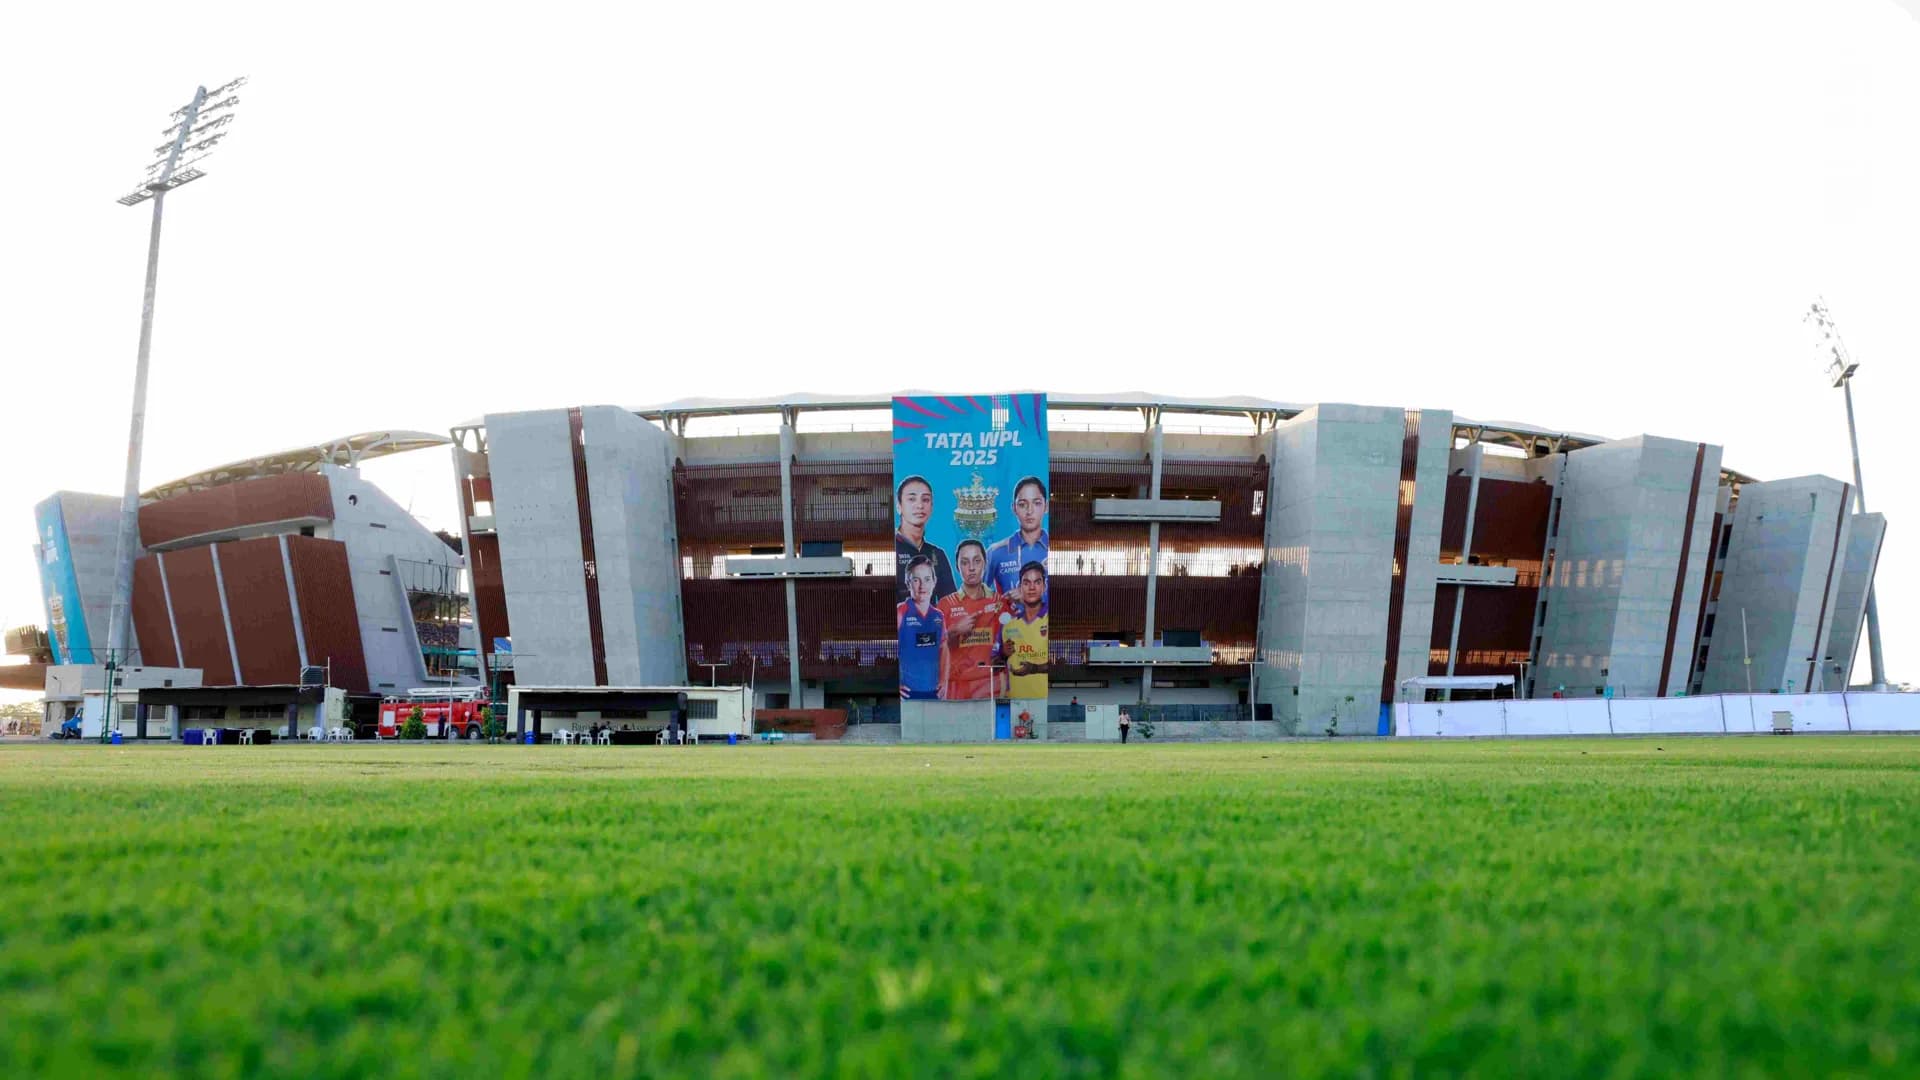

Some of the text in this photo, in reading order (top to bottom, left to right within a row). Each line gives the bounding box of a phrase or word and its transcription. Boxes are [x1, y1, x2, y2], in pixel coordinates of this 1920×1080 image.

[924, 430, 1023, 449] TATA WPL
[950, 449, 998, 466] 2025
[1000, 560, 1017, 568] TATA
[1019, 644, 1034, 653] RR
